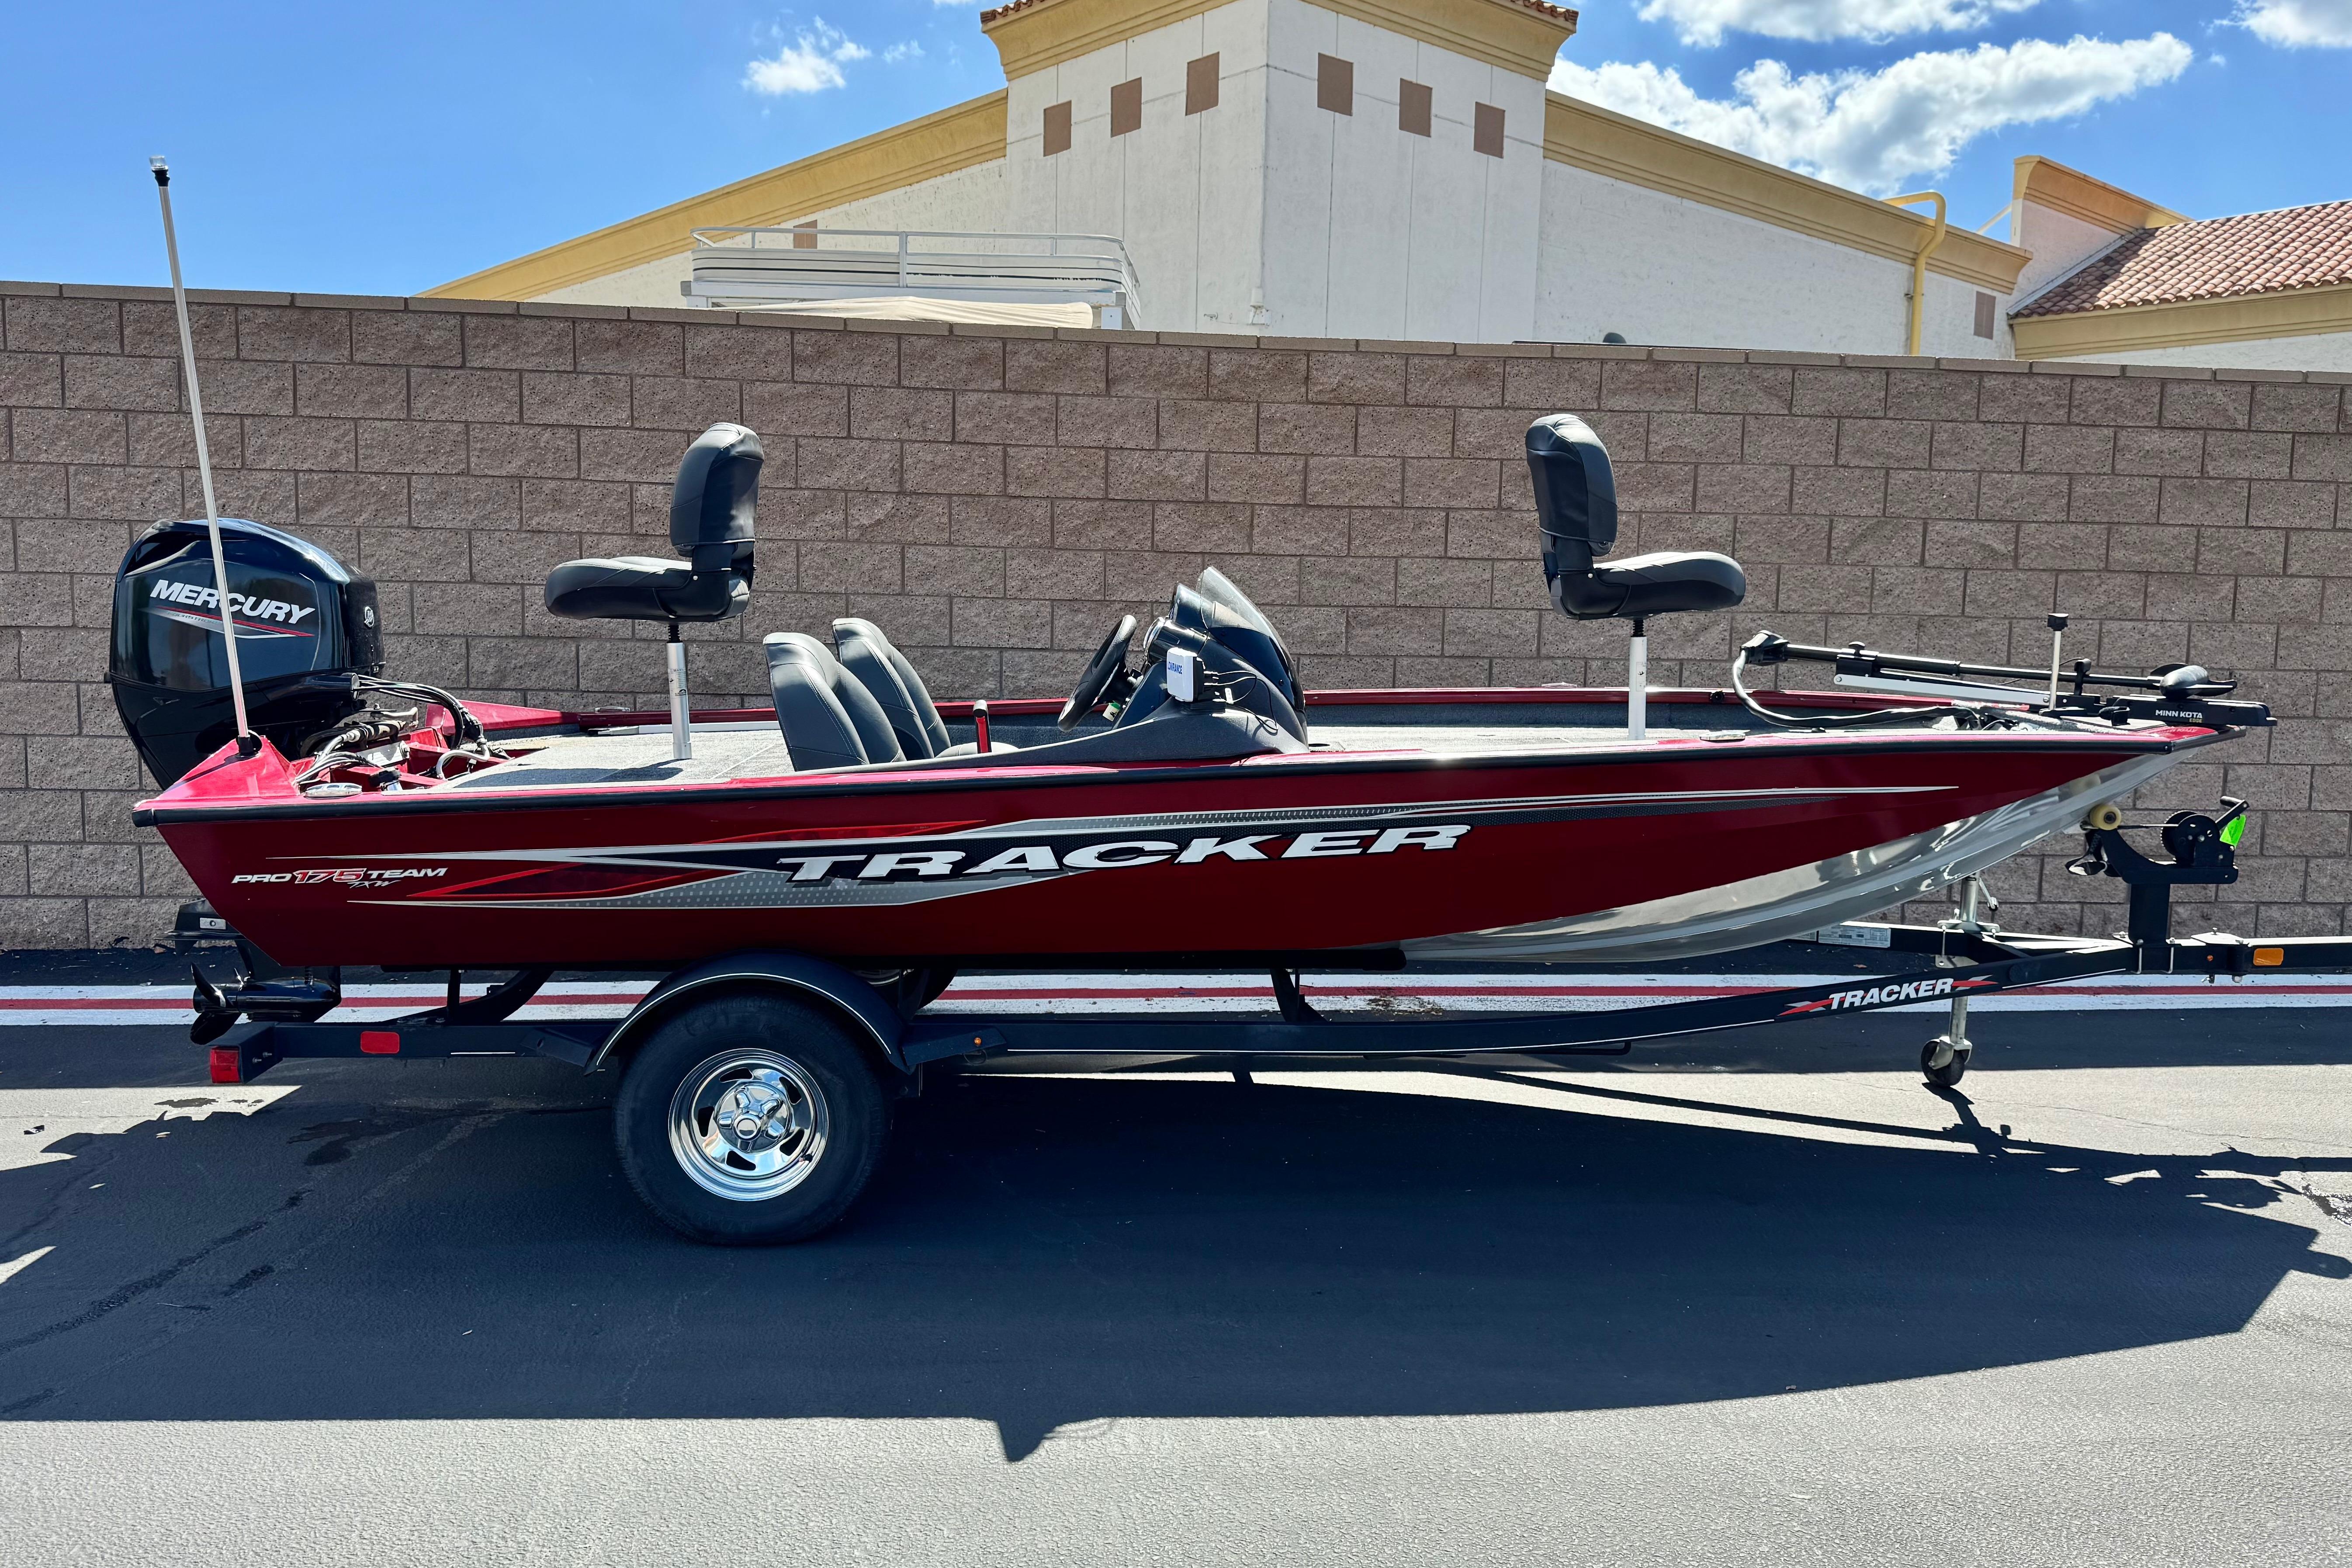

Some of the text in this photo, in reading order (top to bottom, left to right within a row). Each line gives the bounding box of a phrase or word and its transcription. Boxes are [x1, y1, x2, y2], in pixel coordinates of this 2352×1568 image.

[150, 579, 315, 624] MERCURY
[776, 824, 1472, 881] TRACKER
[231, 867, 448, 884] PRO 175 TEAM
[1829, 978, 1954, 1010] TRACKER
